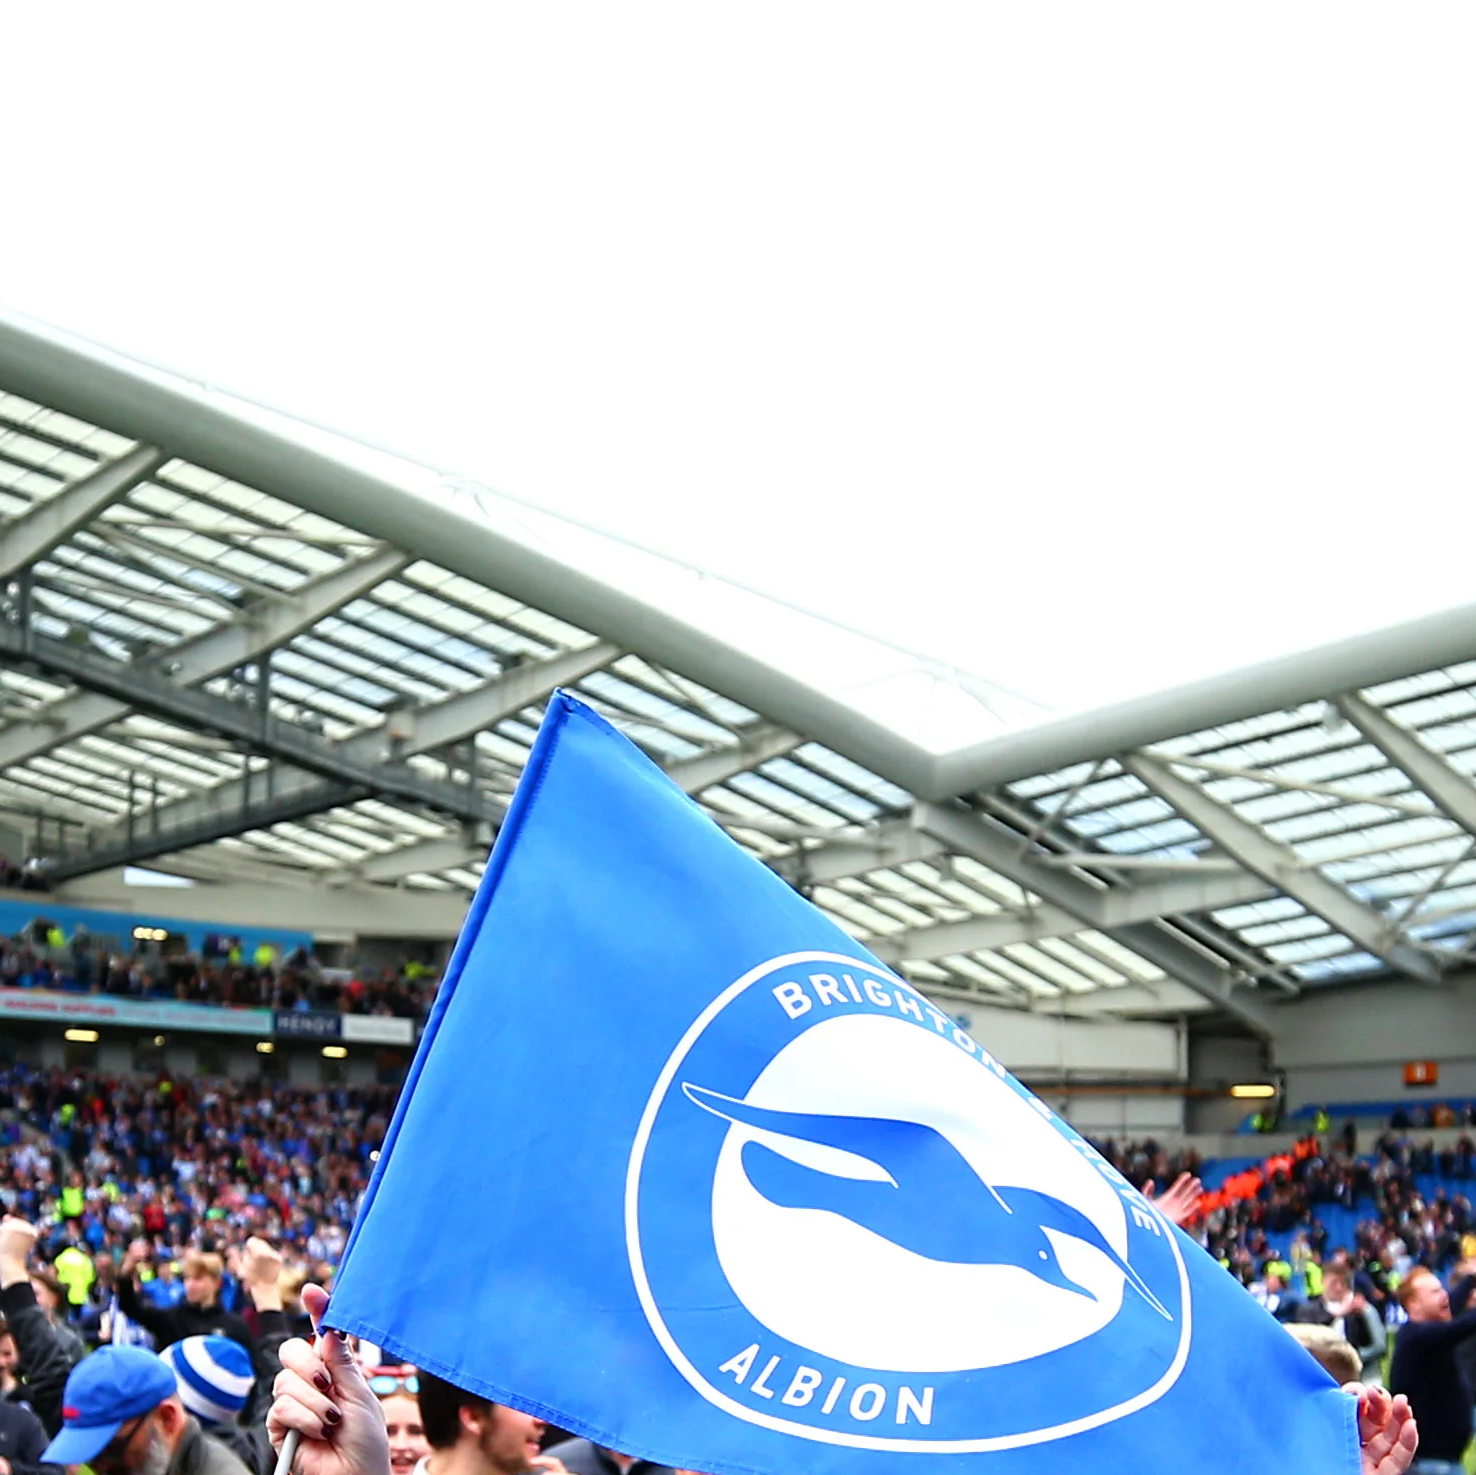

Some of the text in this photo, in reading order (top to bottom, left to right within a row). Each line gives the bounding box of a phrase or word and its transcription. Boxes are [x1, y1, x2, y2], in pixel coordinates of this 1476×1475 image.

[772, 973, 1008, 1080] BRIGHTON
[1069, 1138, 1163, 1237] HOVE
[718, 1343, 935, 1425] ALBION
